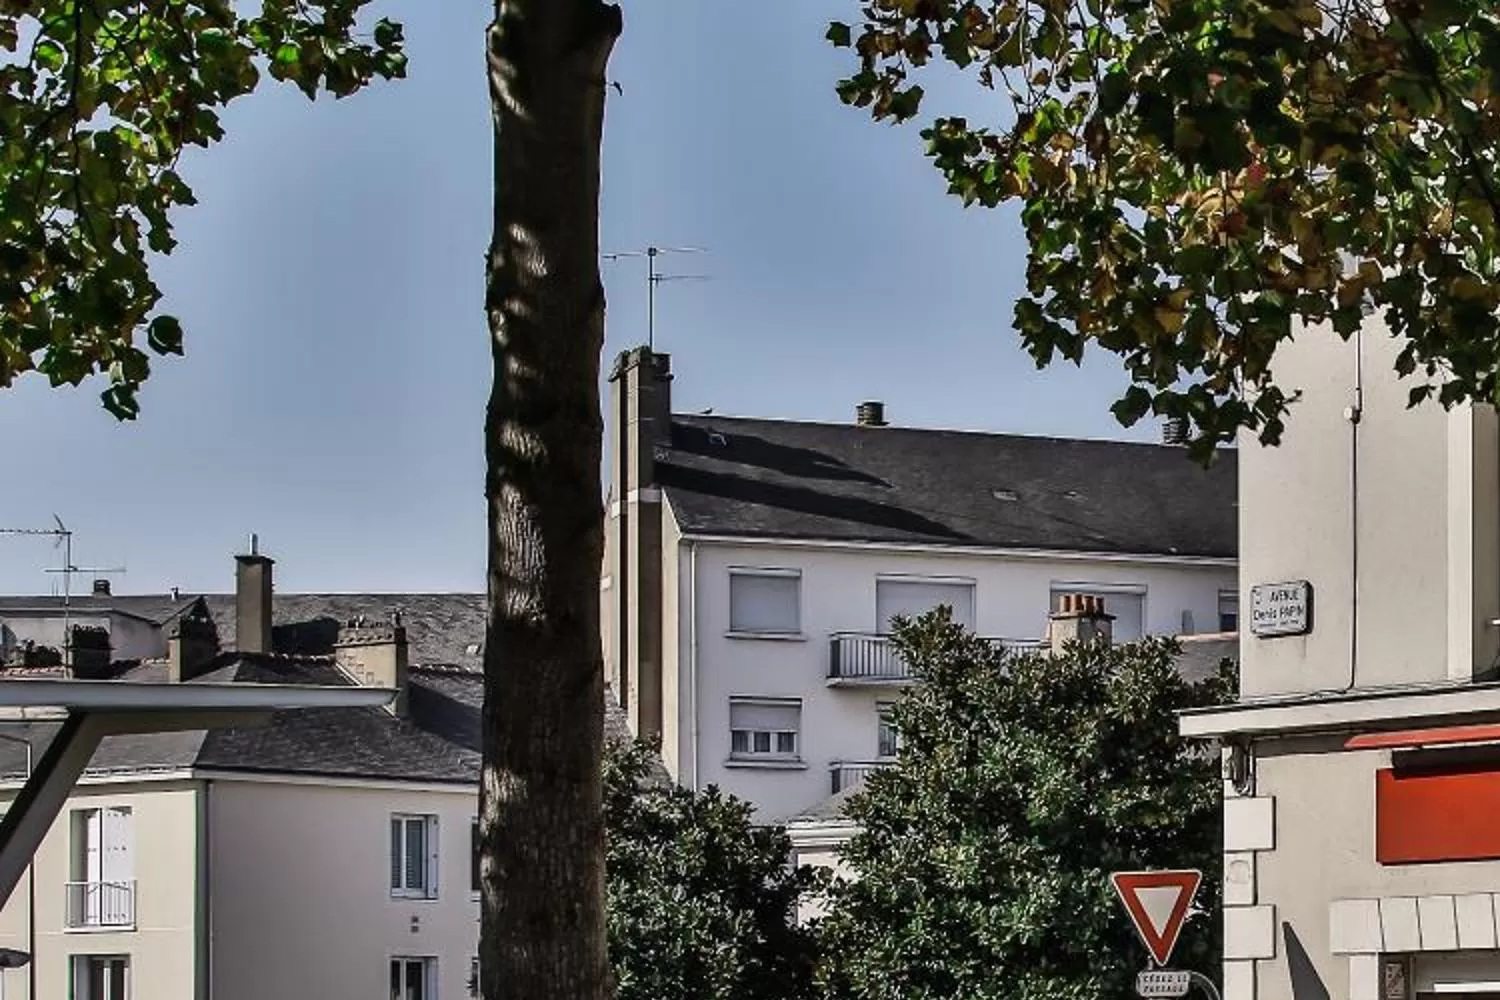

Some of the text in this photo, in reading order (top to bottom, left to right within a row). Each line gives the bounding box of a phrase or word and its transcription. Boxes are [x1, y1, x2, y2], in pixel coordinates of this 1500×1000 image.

[1269, 588, 1300, 602] AVENUE
[1253, 604, 1305, 621] Denis PAPIN
